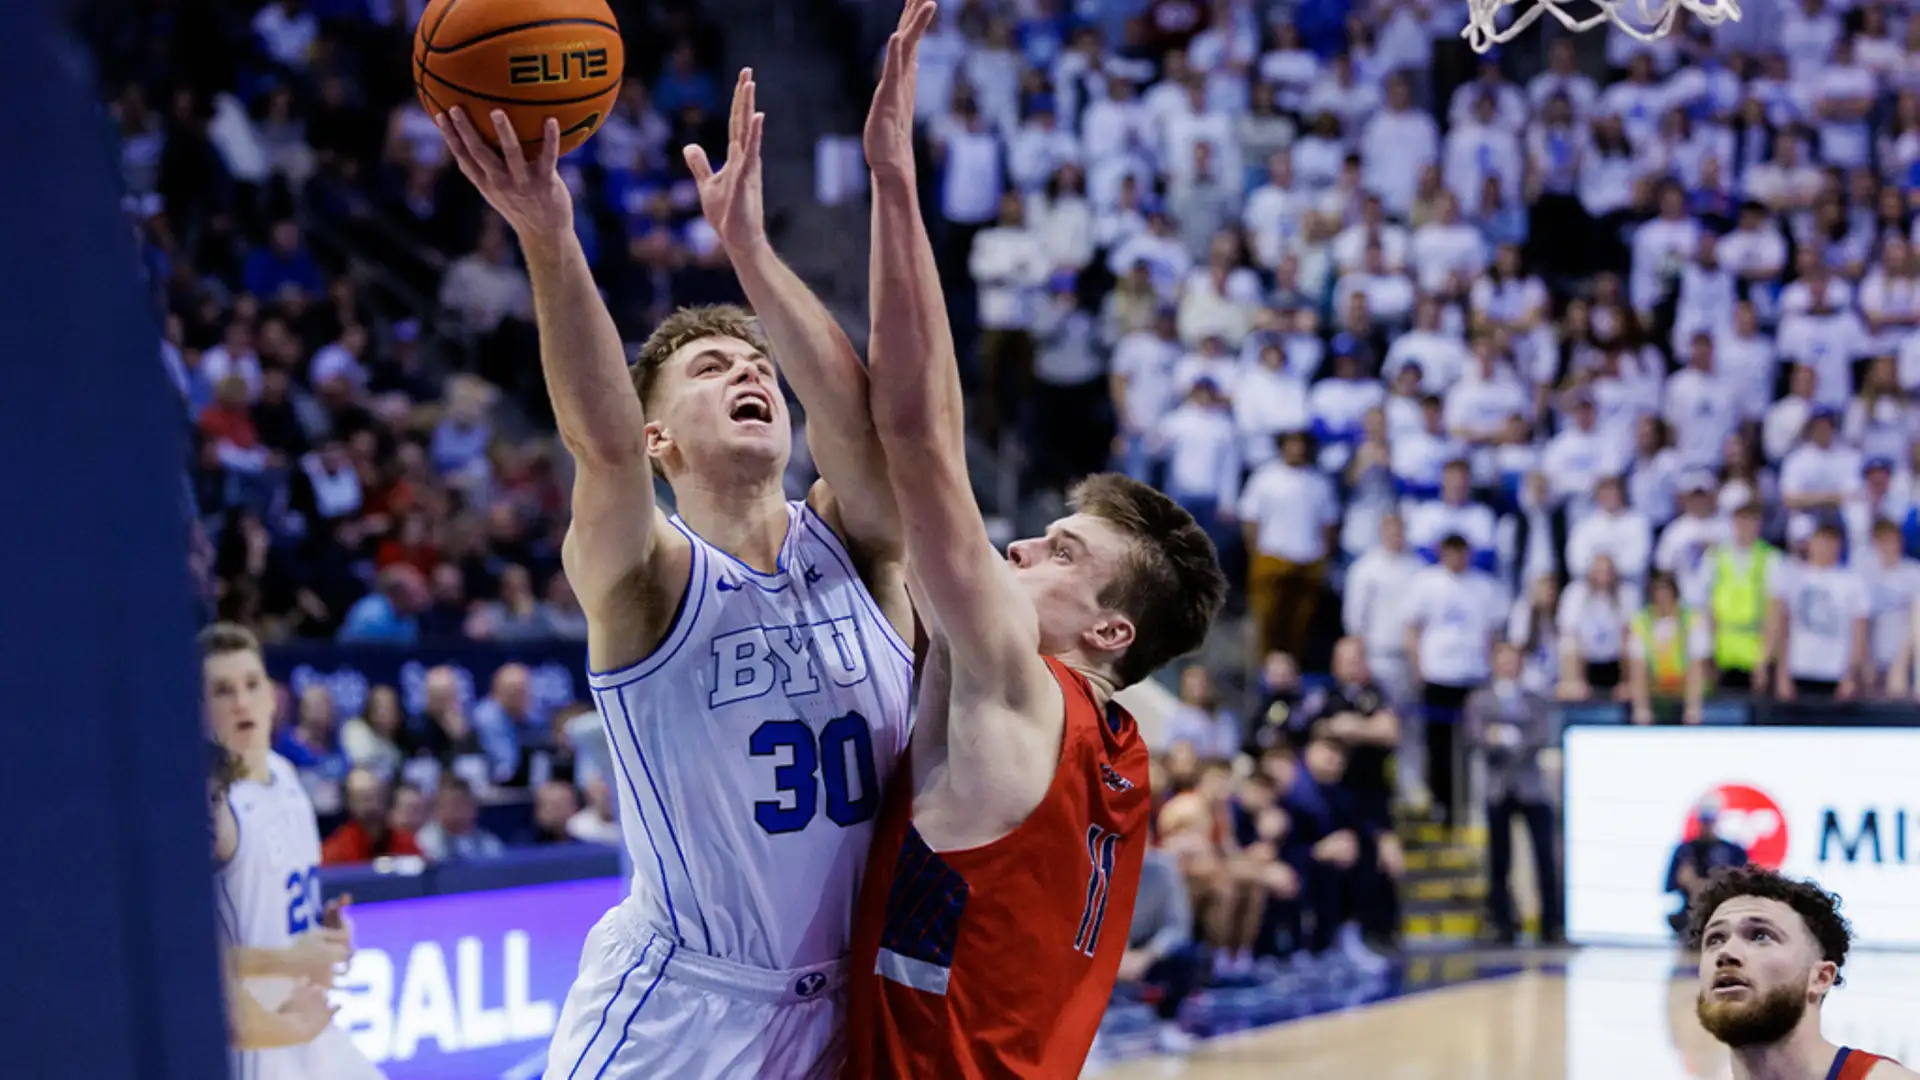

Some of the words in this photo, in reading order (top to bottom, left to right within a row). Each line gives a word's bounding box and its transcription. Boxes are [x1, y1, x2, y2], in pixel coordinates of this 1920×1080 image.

[509, 48, 608, 86] ELITE
[709, 615, 869, 710] BYU
[749, 709, 879, 835] 30
[1073, 822, 1121, 958] 11
[1817, 807, 1920, 863] MI
[327, 928, 557, 1062] BALL
